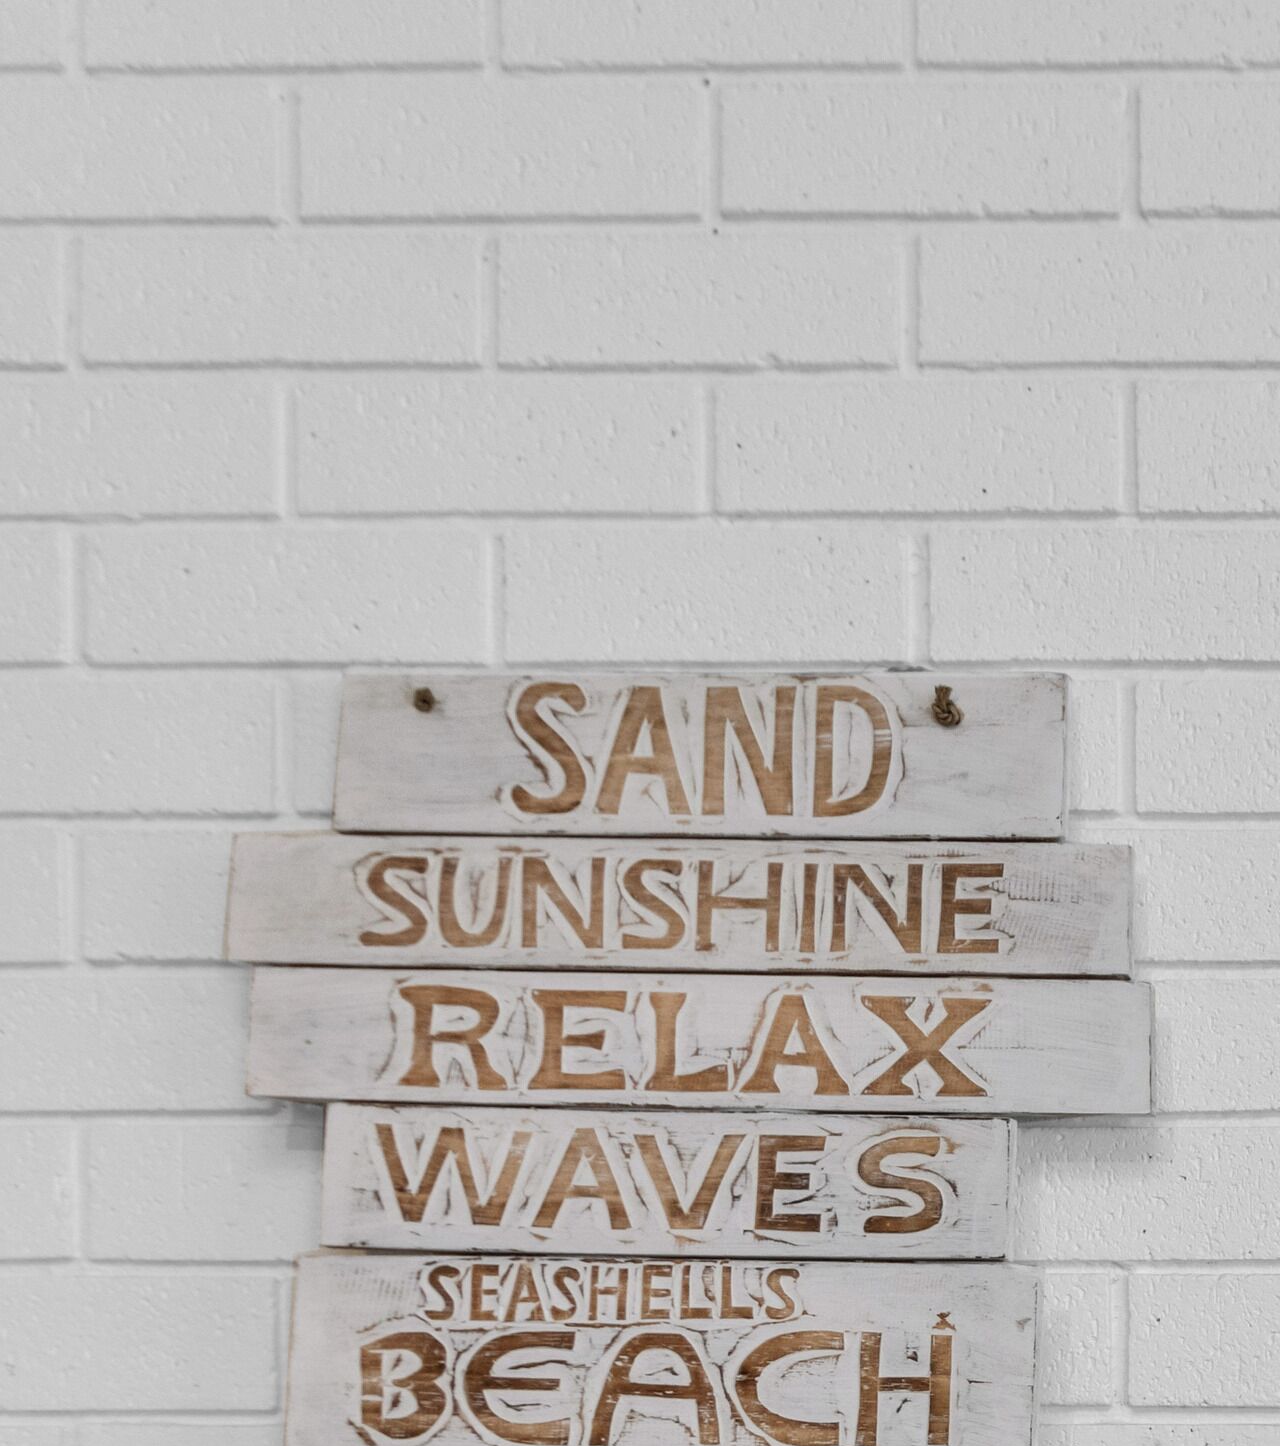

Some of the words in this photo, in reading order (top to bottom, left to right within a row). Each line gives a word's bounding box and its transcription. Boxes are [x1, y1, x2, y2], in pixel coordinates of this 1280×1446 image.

[511, 683, 896, 818] SAND
[359, 856, 1005, 954] SUNSHINE
[396, 985, 992, 1096] RELAX
[374, 1123, 950, 1234] WAVES
[423, 1264, 801, 1321] SEASHELLS
